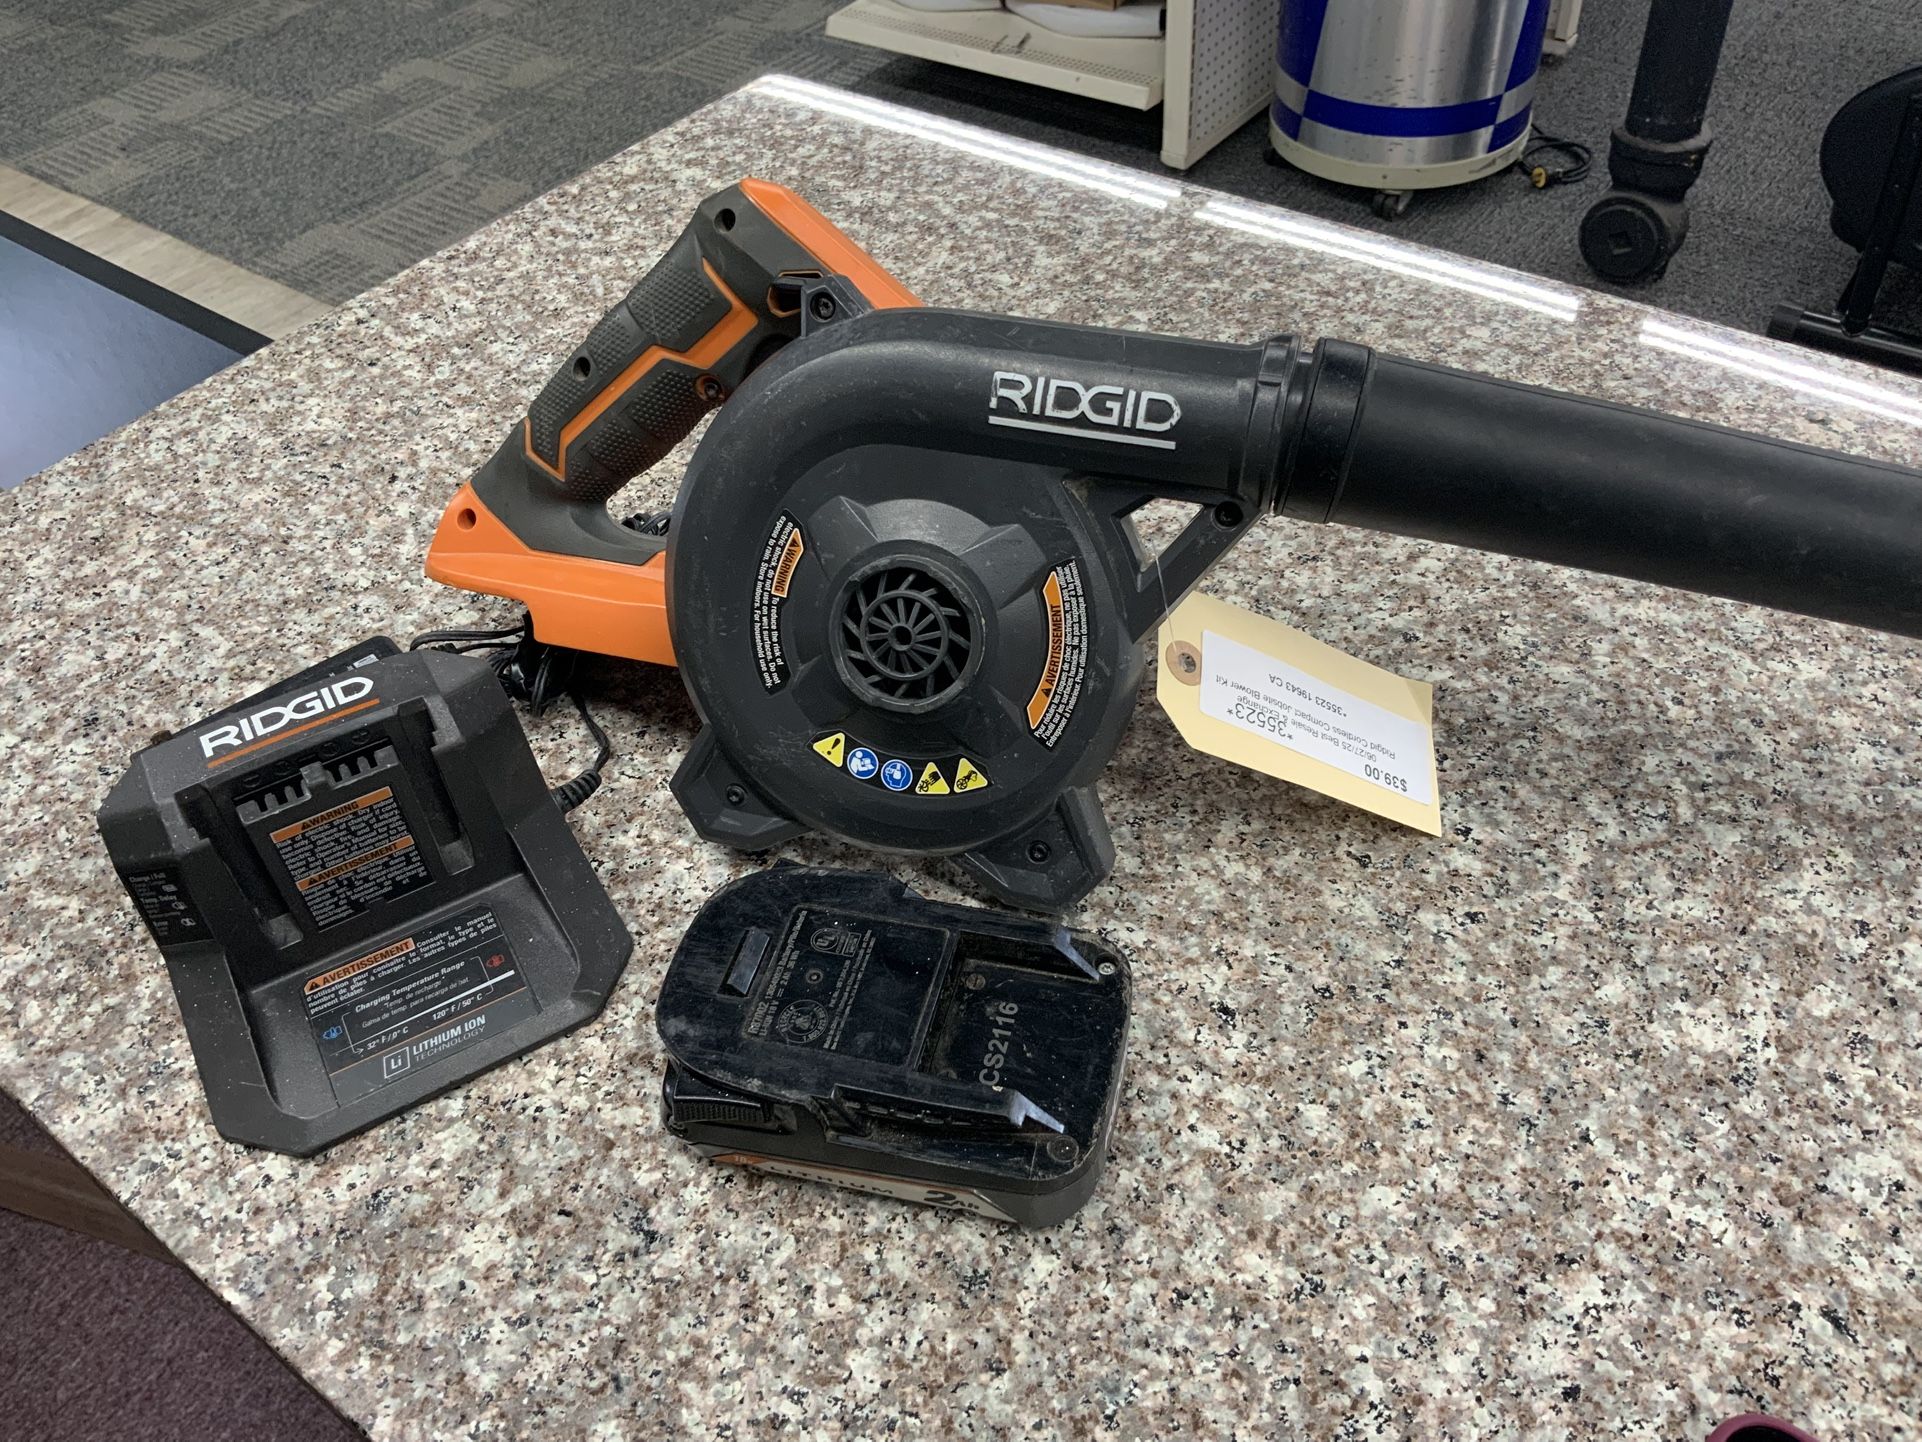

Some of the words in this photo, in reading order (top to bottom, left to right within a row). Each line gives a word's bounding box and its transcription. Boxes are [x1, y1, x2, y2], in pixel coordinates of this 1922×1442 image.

[989, 371, 1182, 432] RIDGID
[772, 515, 787, 539] expose
[778, 522, 793, 547] electric
[768, 538, 777, 546] to
[758, 562, 769, 581] Store
[767, 569, 775, 579] do
[775, 549, 797, 592] WARNING
[764, 579, 772, 591] not
[762, 592, 770, 605] use
[771, 597, 779, 605] To
[753, 610, 761, 622] For
[762, 605, 768, 615] on
[754, 622, 766, 658] household
[771, 631, 779, 642] the
[1045, 604, 1063, 687] AVERTISSEMENT
[772, 643, 781, 657] risk
[760, 659, 768, 672] use
[769, 662, 777, 672] Do
[776, 657, 784, 665] of
[771, 672, 781, 685] not
[1216, 675, 1227, 686] Kit
[1268, 674, 1282, 687] CA
[1033, 724, 1046, 738] Pour
[1062, 662, 1070, 671] de
[1230, 682, 1260, 700] Blower
[1286, 682, 1312, 701] 19643
[1237, 696, 1279, 720] Exchange
[1263, 694, 1292, 713] Jobsite
[200, 676, 374, 758] RIDGID
[1294, 709, 1330, 731] Compact
[1291, 718, 1318, 737] Resale
[1332, 726, 1367, 748] Cordless
[1321, 732, 1339, 746] Best
[1342, 741, 1376, 762] 06/27/25
[1370, 742, 1395, 759] Ridgid
[1364, 764, 1407, 792] $39.00
[308, 801, 359, 827] WARNING
[318, 843, 397, 881] AVERTISSEMENT
[323, 942, 409, 984] AVERTISSEMENT
[416, 931, 449, 948] Consulter
[466, 912, 492, 926] manuel
[306, 981, 349, 1002] d'utilisation
[352, 972, 369, 983] pour
[419, 939, 446, 953] format,
[458, 927, 474, 937] type
[308, 993, 335, 1008] nombre
[350, 979, 368, 991] piles
[378, 963, 406, 978] charger.
[408, 956, 421, 964] Les
[422, 946, 446, 958] autres
[447, 936, 467, 948] types
[480, 923, 497, 934] piles
[355, 994, 390, 1013] Charging
[392, 972, 439, 996] Temperature
[440, 961, 465, 975] Range
[405, 992, 414, 1000] de
[414, 980, 442, 996] recharge
[310, 998, 339, 1014] peuvent
[381, 1012, 390, 1020] de
[409, 997, 424, 1008] para
[424, 986, 449, 1000] recarga
[449, 982, 458, 990] de
[413, 1026, 462, 1055] LITHIUM
[464, 1014, 486, 1032] ION
[415, 1026, 485, 1062] TECHNOLOGY
[978, 1001, 1019, 1087] CS2116
[390, 1055, 402, 1069] Li
